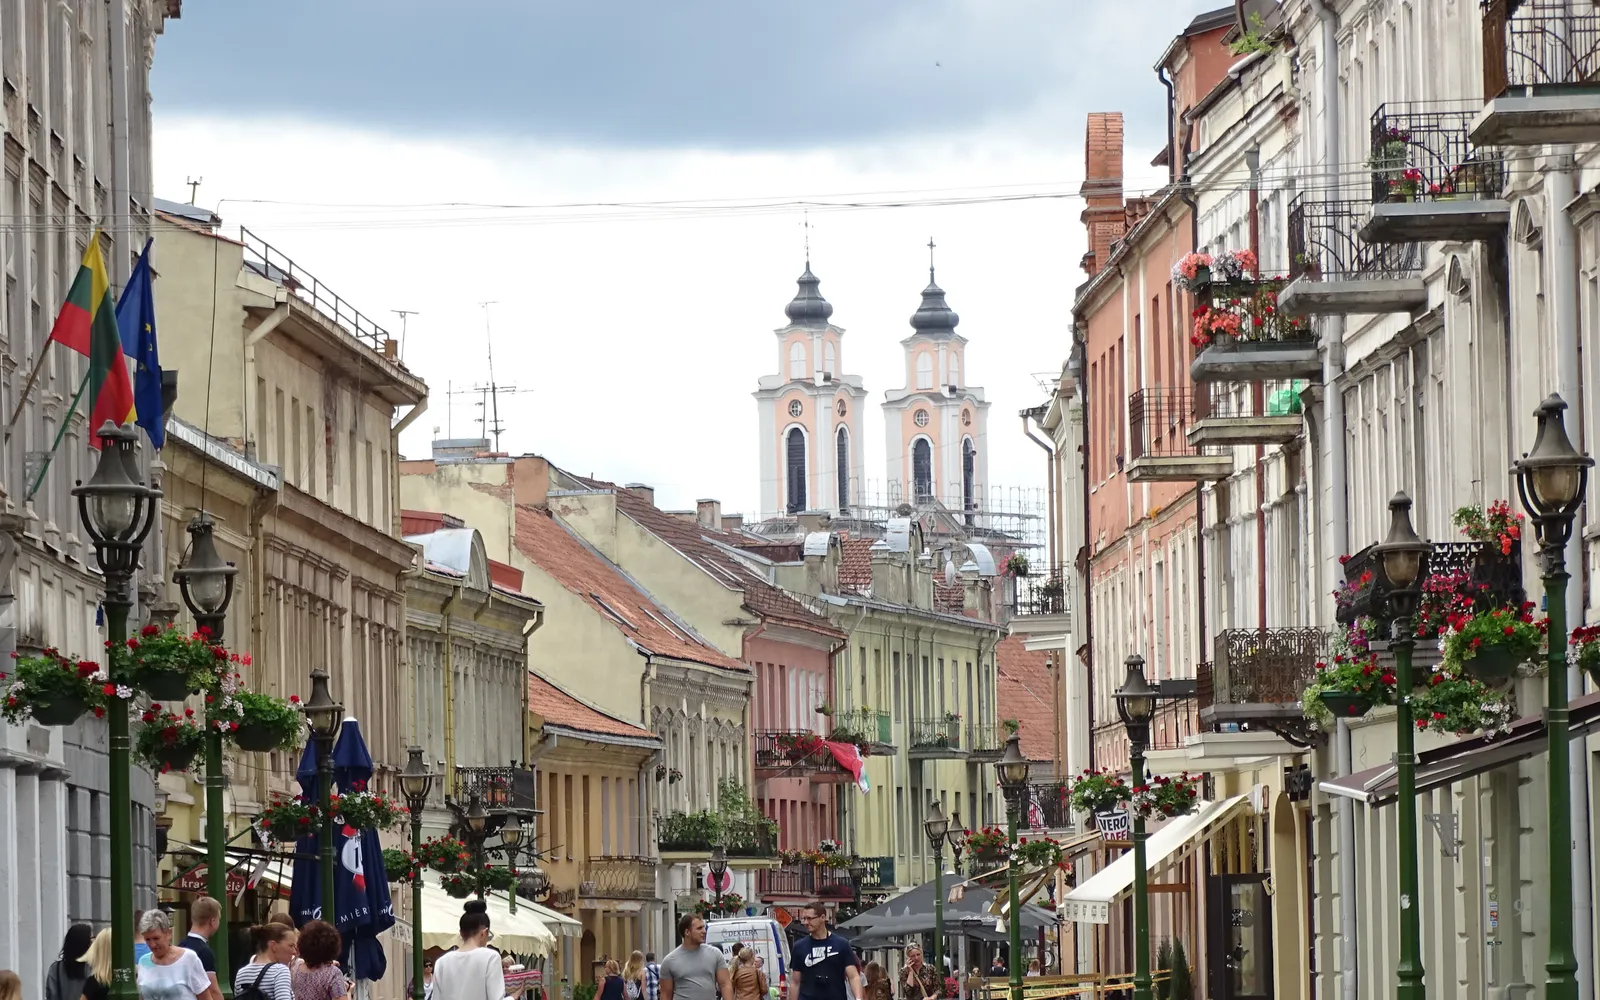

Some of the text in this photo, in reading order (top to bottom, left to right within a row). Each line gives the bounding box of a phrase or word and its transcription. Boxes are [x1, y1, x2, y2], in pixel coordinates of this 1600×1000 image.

[1099, 816, 1127, 831] VERO
[336, 905, 371, 926] MIÈR
[728, 929, 758, 937] DEXTERA
